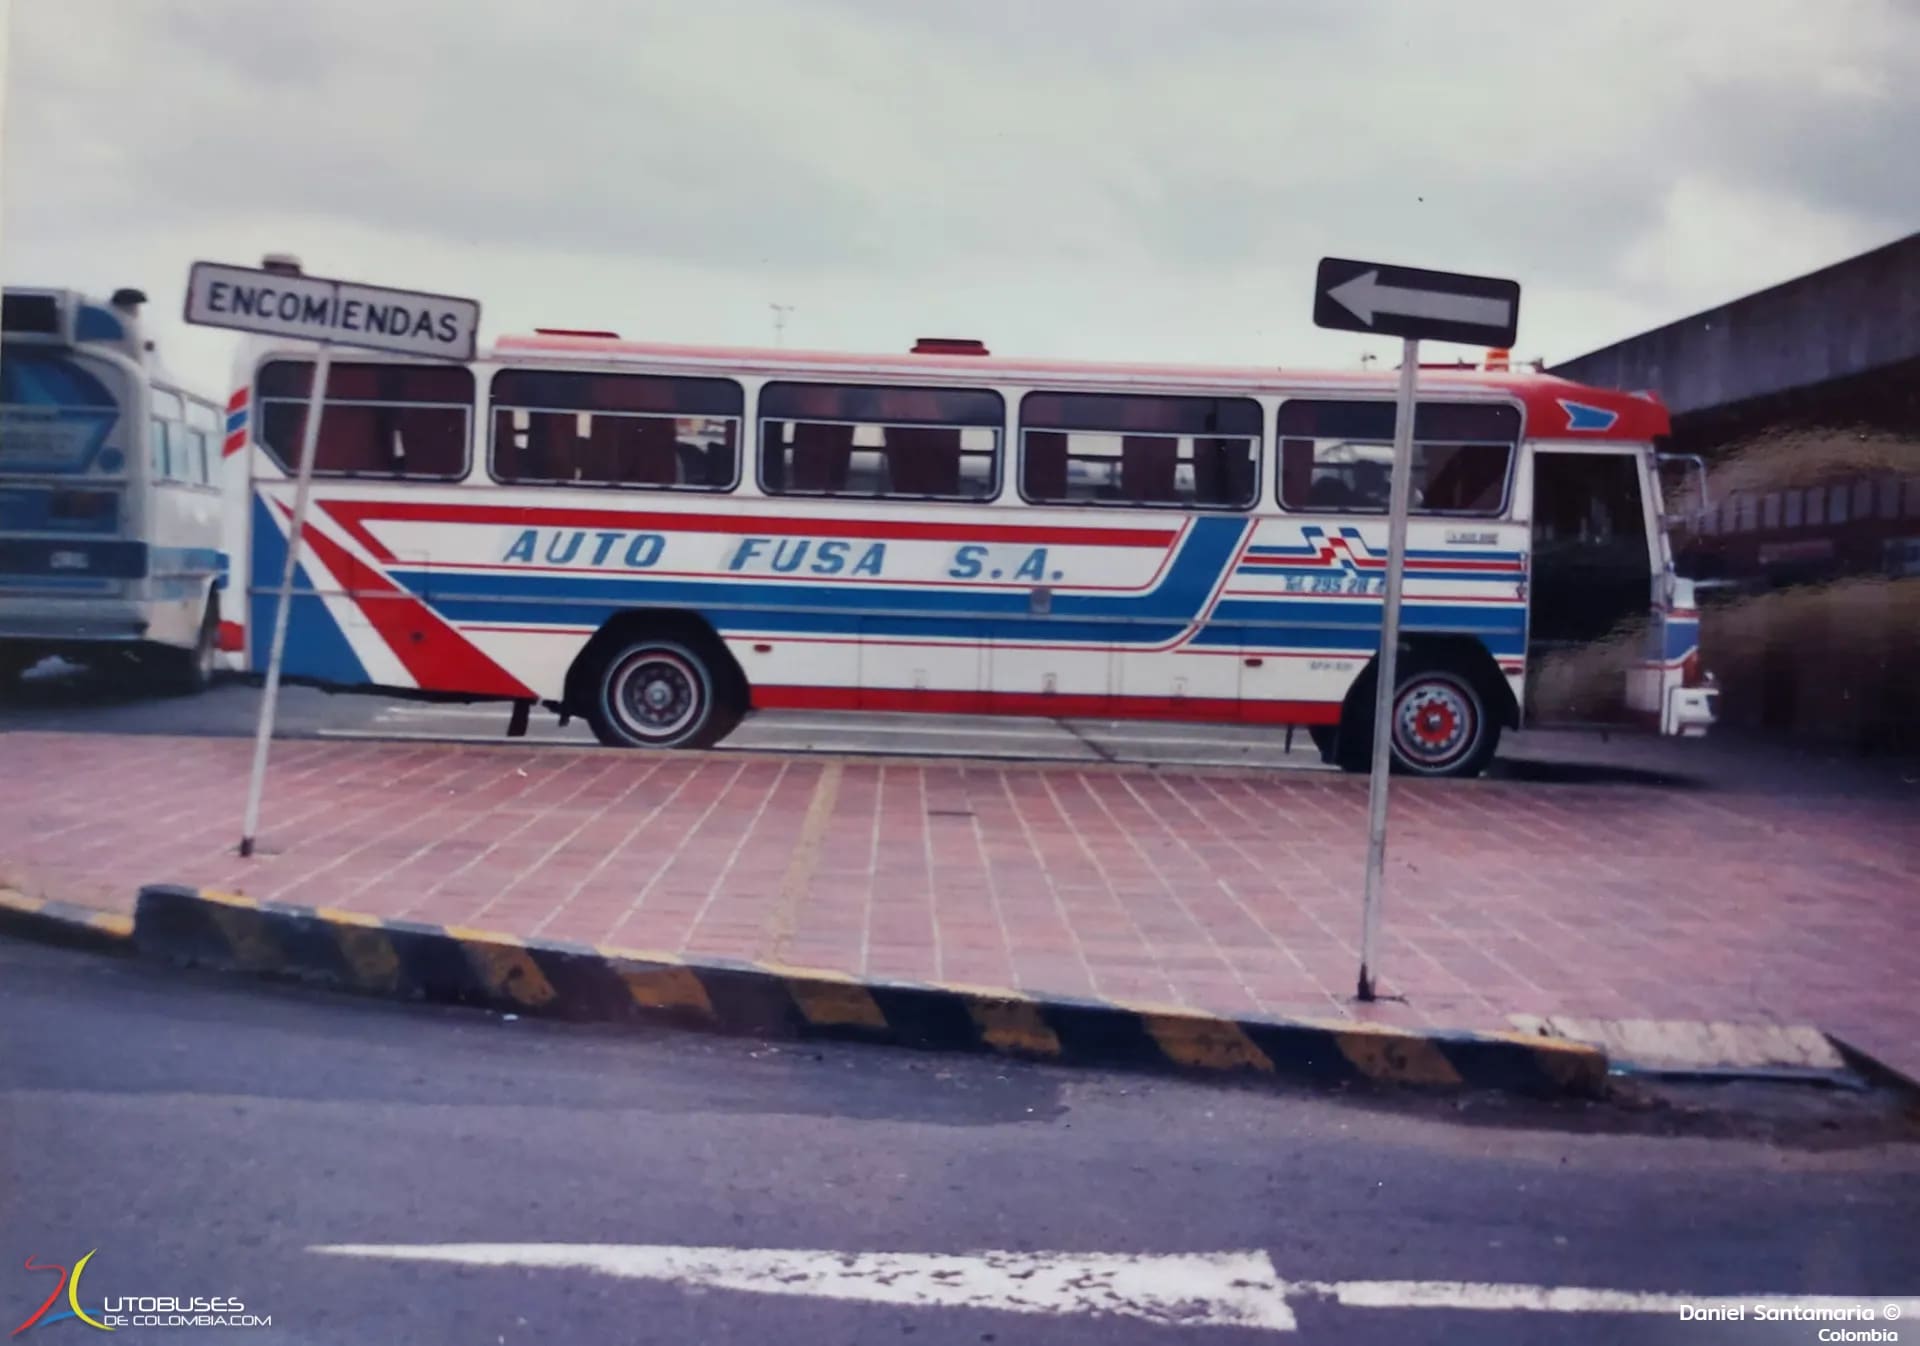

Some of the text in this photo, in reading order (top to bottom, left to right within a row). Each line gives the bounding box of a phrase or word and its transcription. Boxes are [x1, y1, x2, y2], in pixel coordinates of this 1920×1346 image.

[207, 281, 458, 343] ENCOMIENDAS
[502, 529, 1064, 581] AUTO FUSA S.A.
